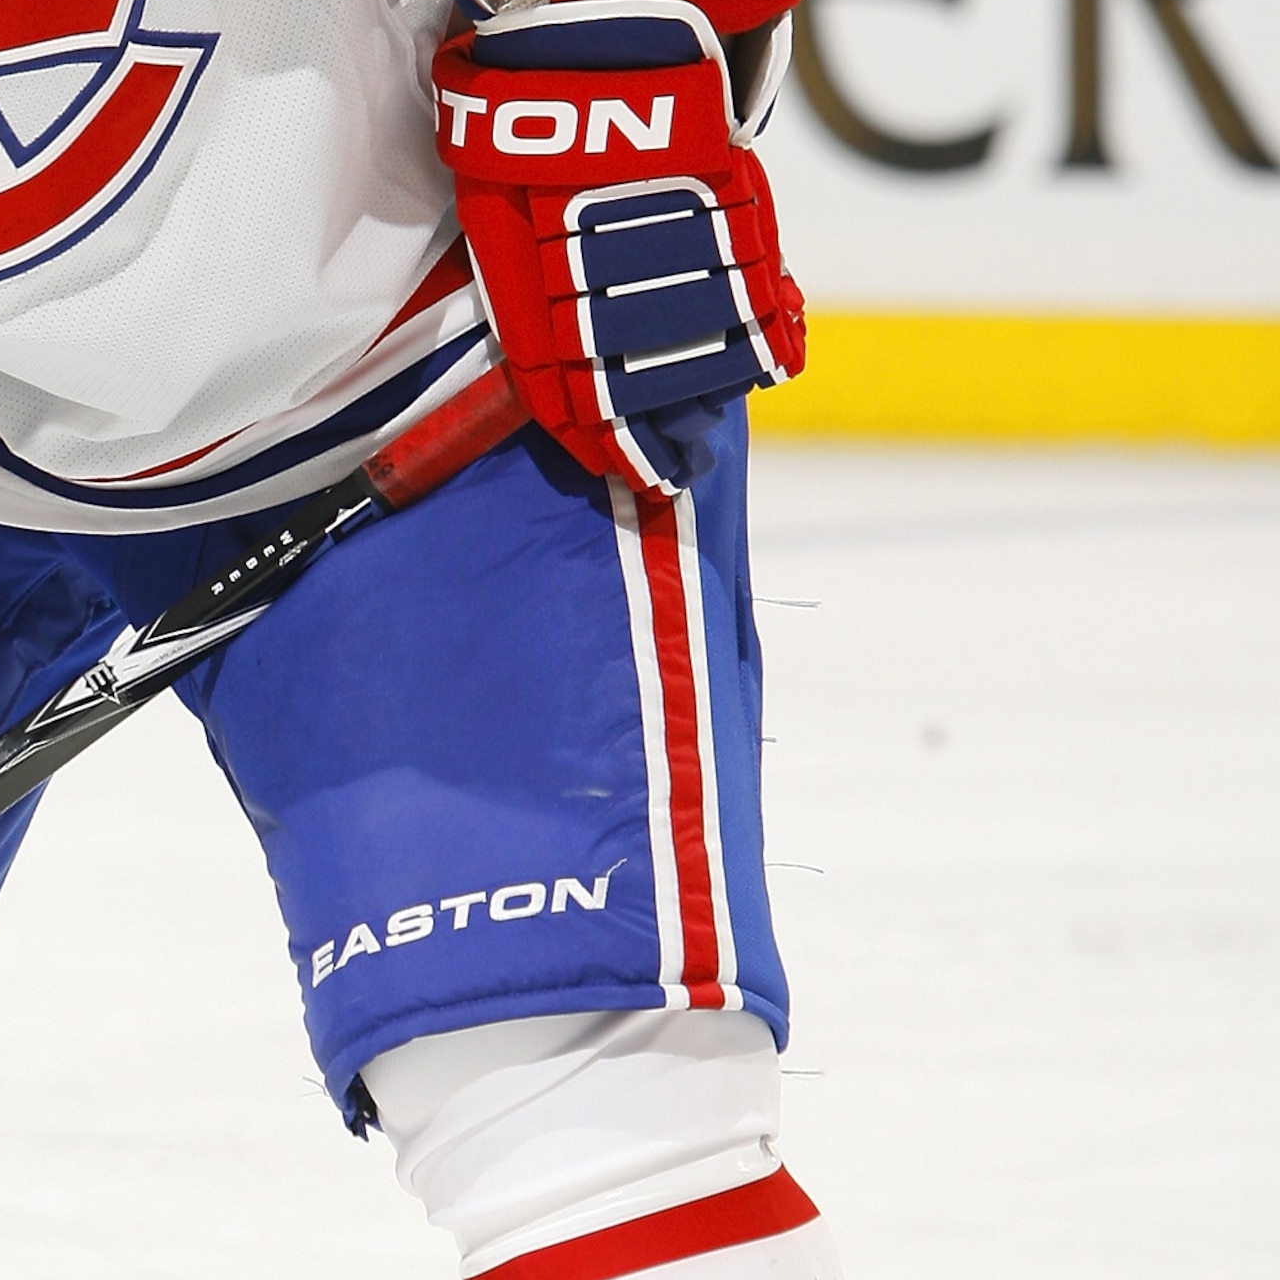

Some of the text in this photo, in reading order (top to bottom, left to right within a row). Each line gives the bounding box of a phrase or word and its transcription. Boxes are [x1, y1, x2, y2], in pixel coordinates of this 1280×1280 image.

[432, 80, 675, 156] TON
[210, 529, 294, 596] WEBER
[311, 877, 610, 988] EASTON
